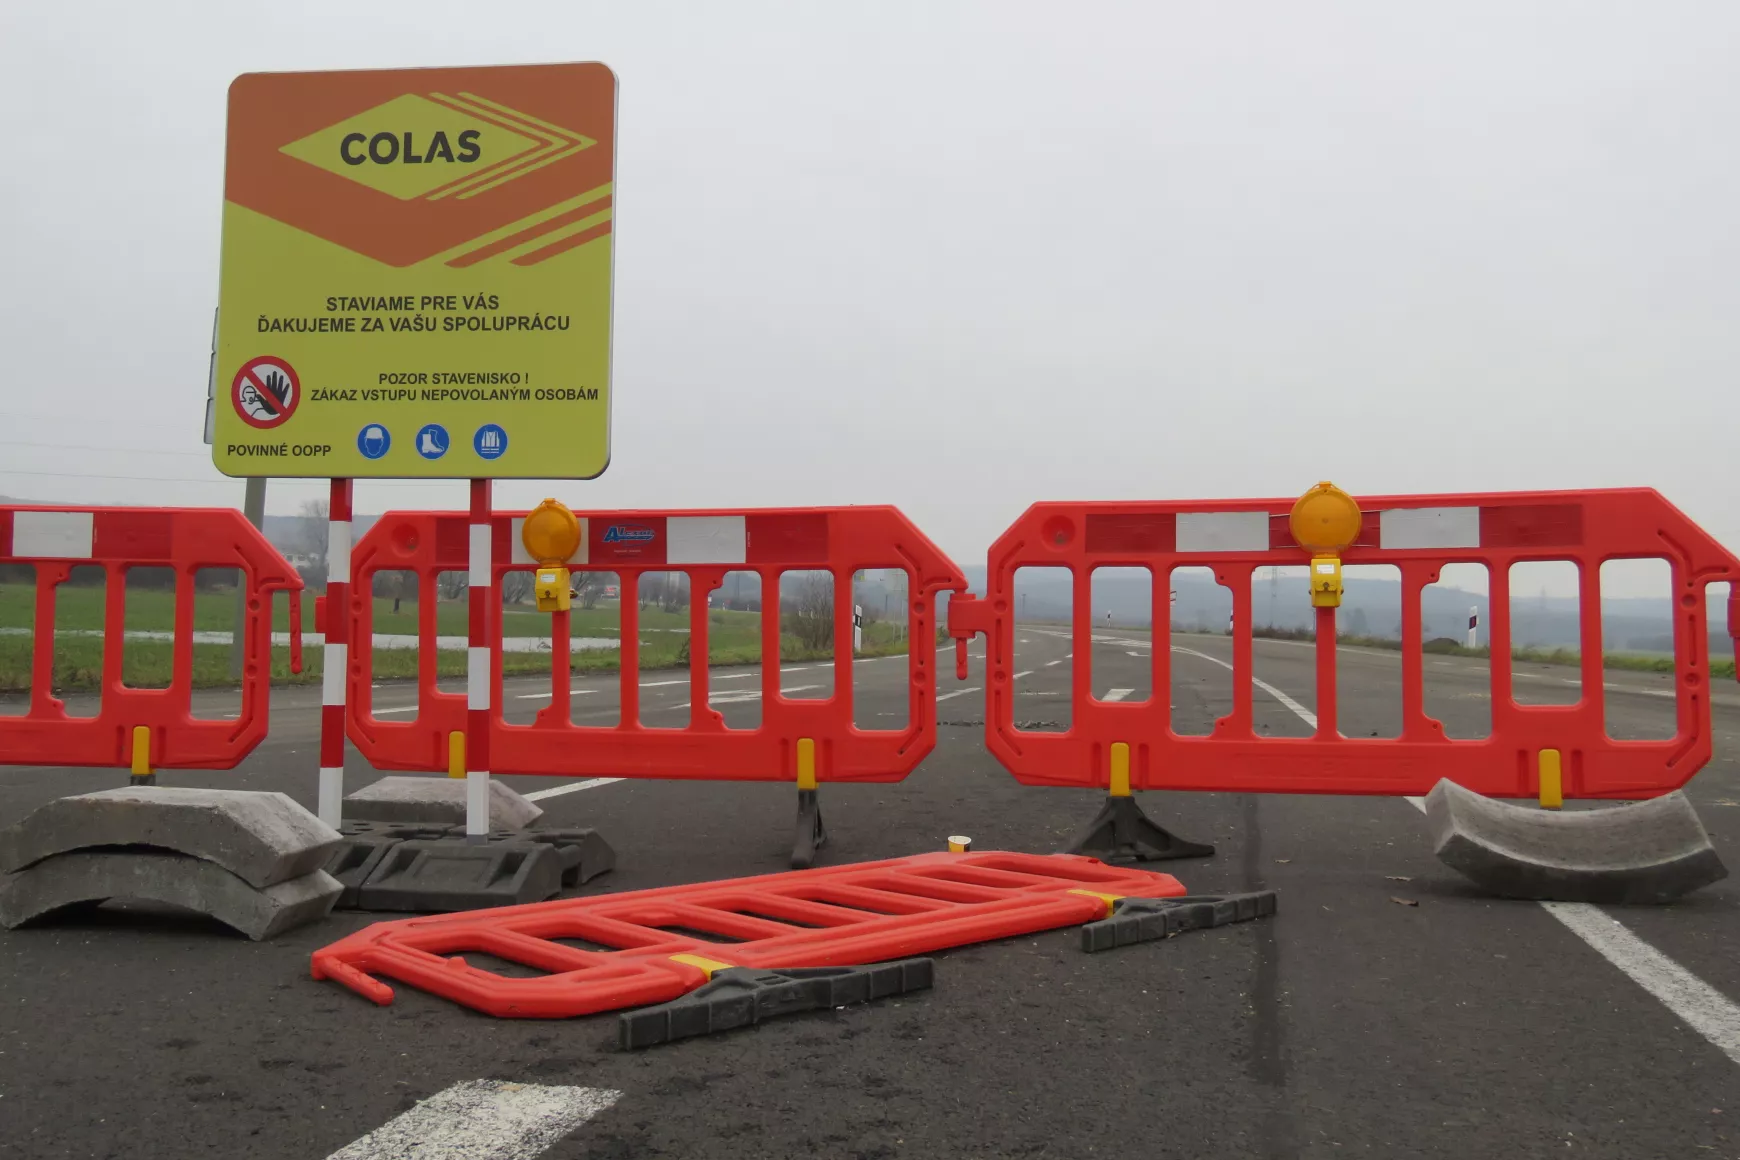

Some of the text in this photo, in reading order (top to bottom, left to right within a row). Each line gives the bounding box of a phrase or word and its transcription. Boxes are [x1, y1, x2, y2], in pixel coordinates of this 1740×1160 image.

[340, 129, 482, 166] COLAS
[326, 291, 500, 312] STAVIAME PRE VÁS
[257, 312, 570, 333] ĎAKUJEME ZA VAŠU SPOLUPRÁCU
[378, 372, 530, 385] POZOR STAVENISKO !
[310, 385, 599, 401] ZÁKAZ VSTUPU NEPOVOLANÝM OSOBÁM
[227, 442, 332, 457] POVINNÉ OOPP
